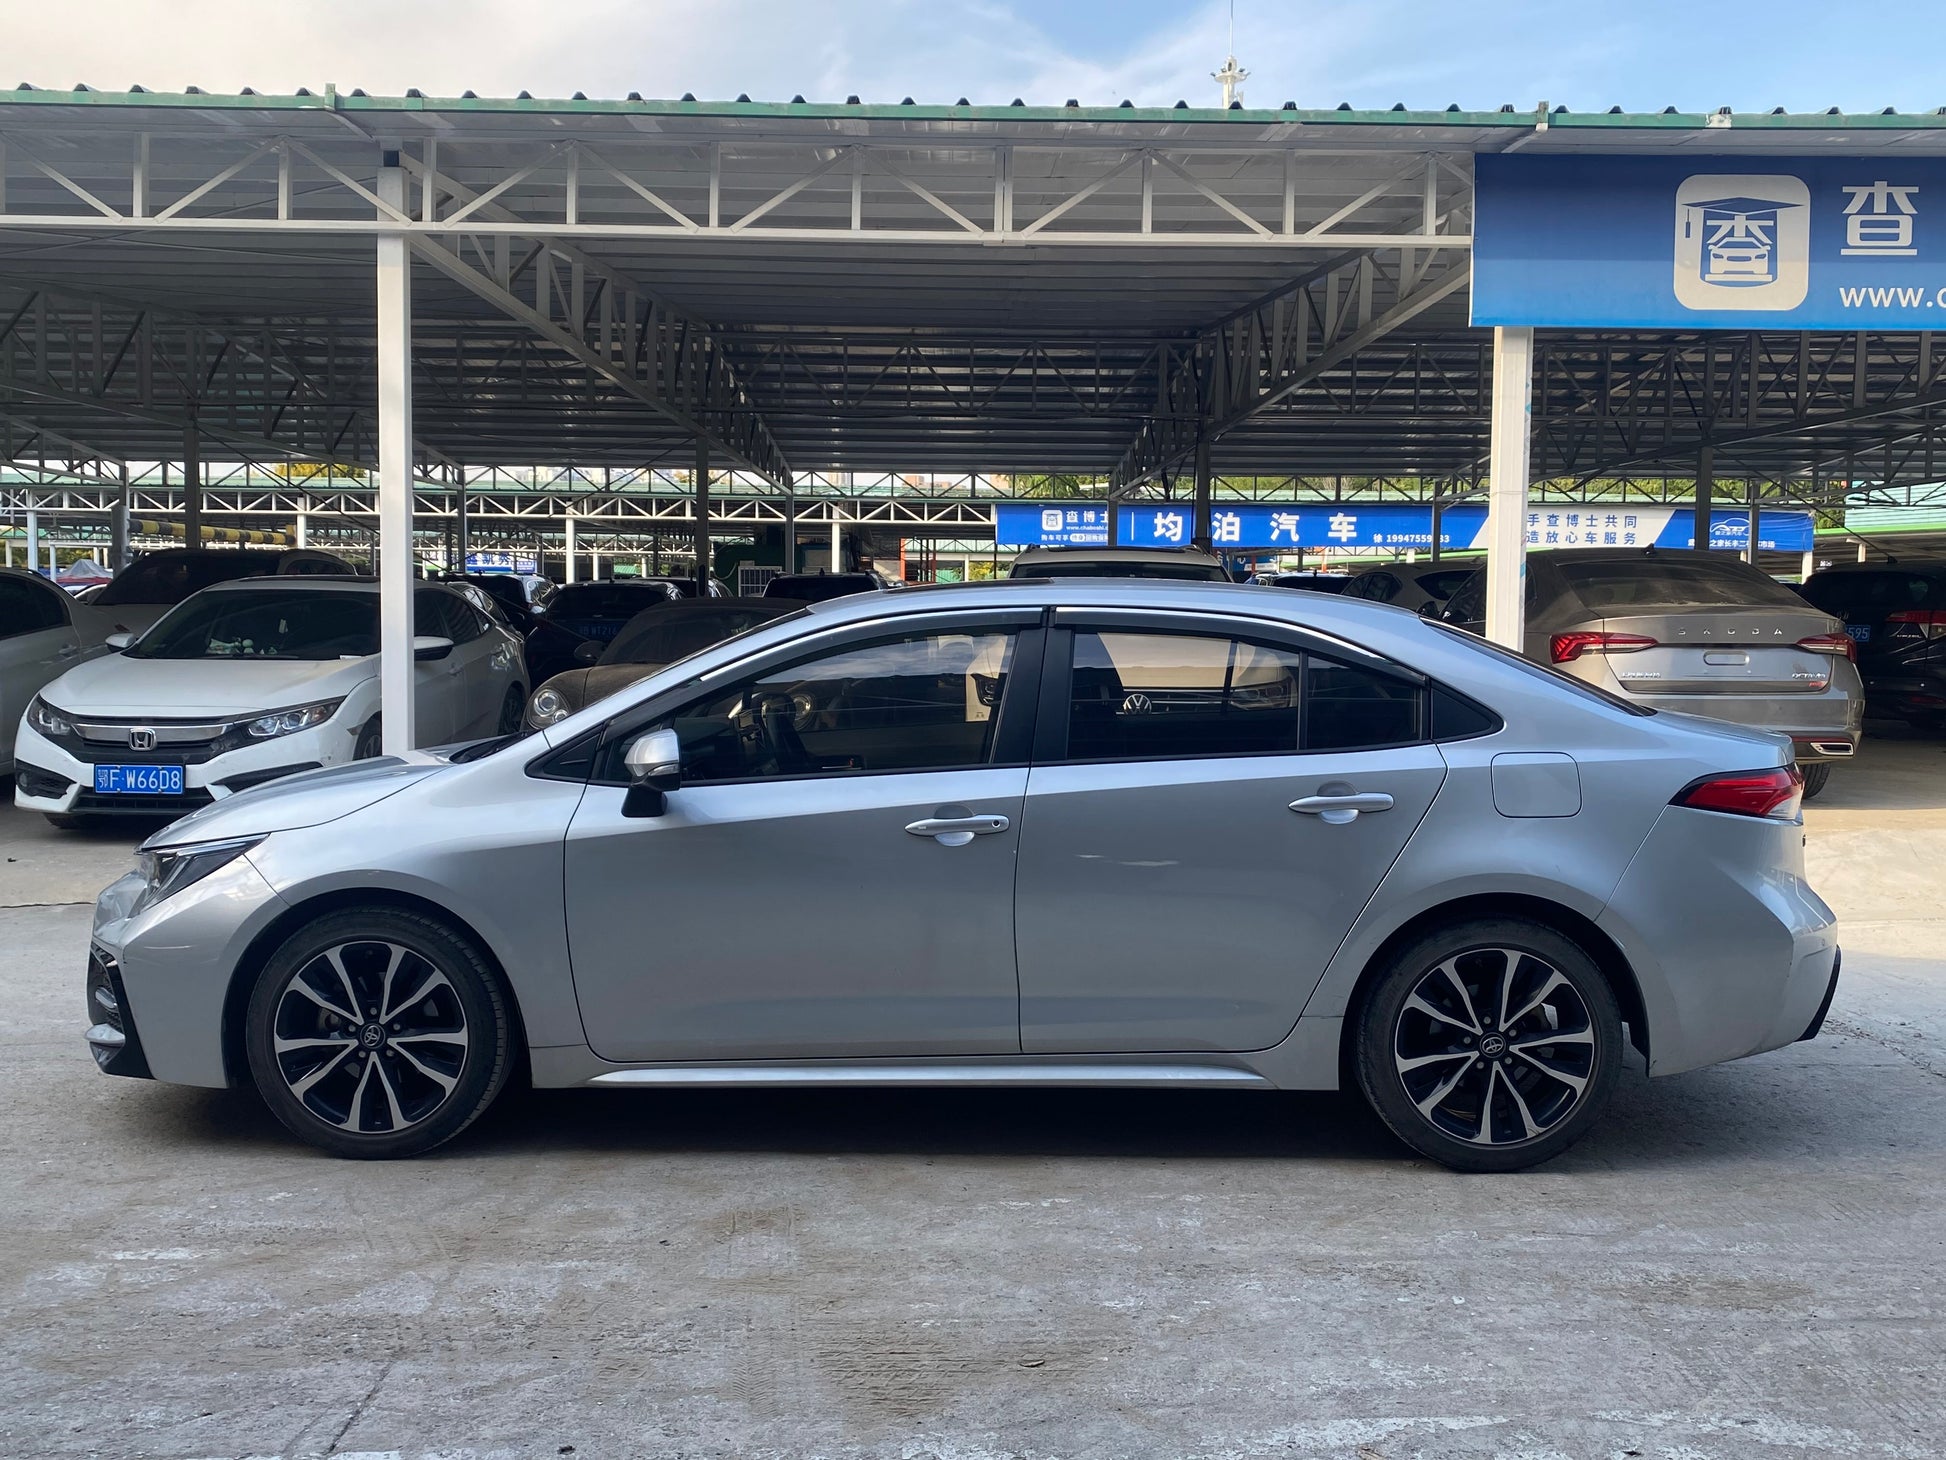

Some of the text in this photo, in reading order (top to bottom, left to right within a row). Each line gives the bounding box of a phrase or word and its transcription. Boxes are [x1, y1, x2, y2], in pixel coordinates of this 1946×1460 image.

[1841, 181, 1919, 255] 查
[1153, 512, 1358, 542] 均泊汽车
[1527, 513, 1637, 528] 手查博士共同
[1526, 531, 1636, 545] 造放心车服务
[1846, 627, 1868, 639] 595
